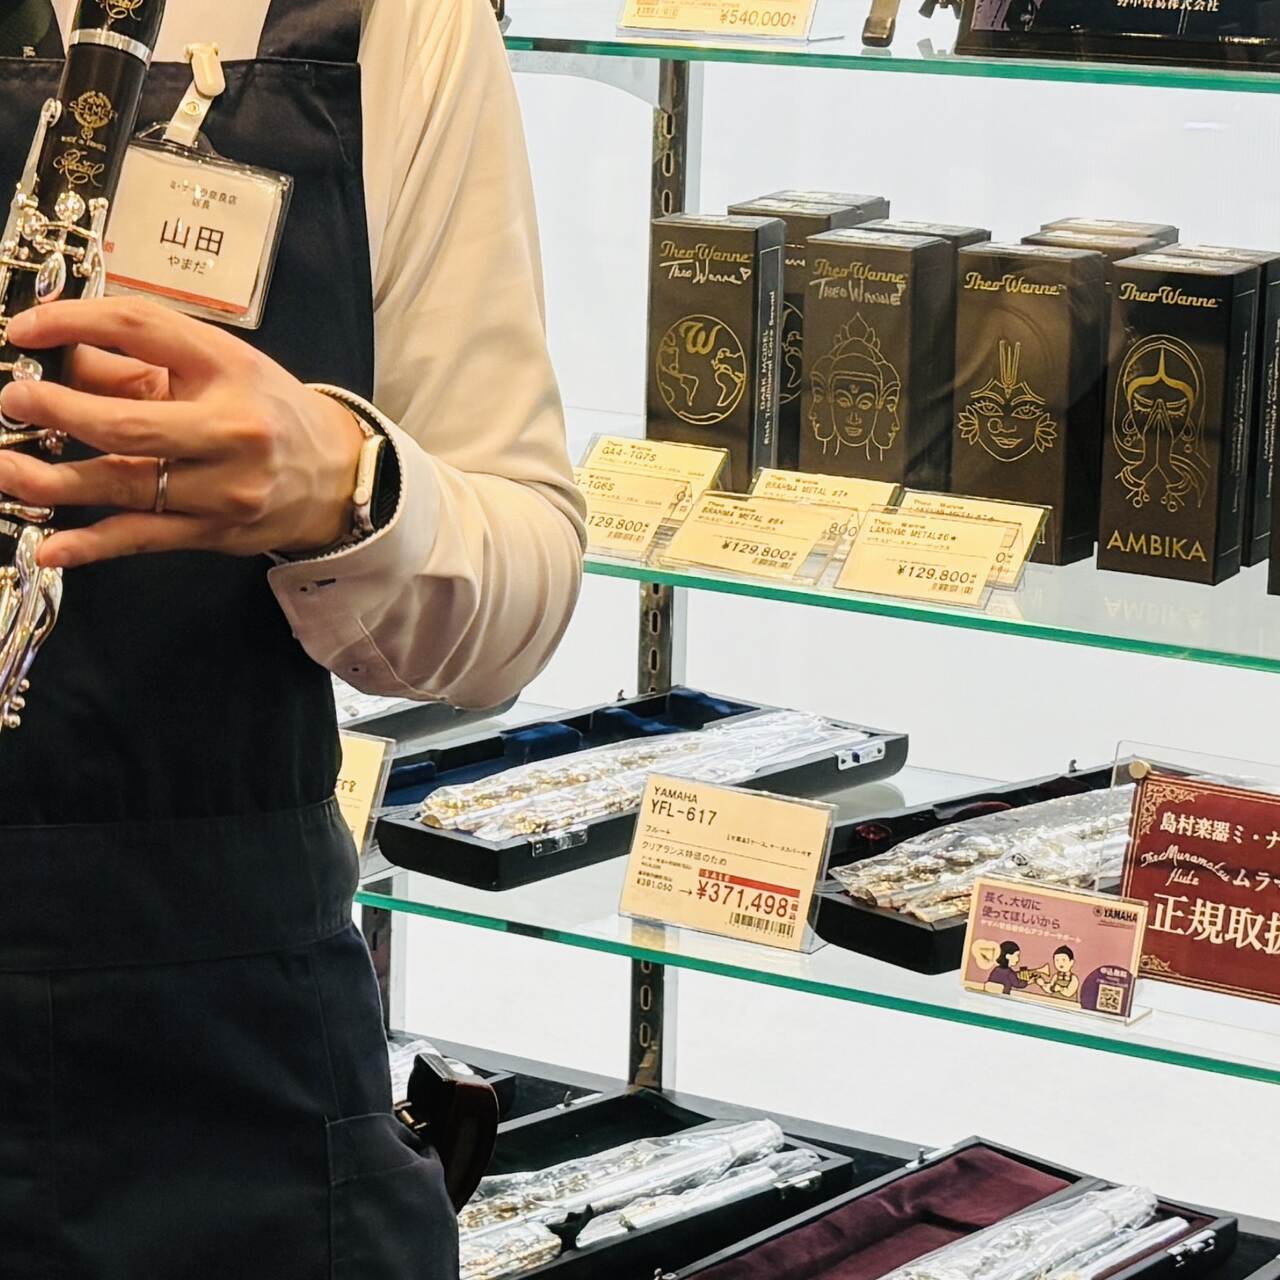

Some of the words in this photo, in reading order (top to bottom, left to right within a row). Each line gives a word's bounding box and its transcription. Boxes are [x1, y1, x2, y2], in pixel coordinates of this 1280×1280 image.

[720, 9, 792, 28] ¥540,000
[159, 216, 225, 257] 山田
[659, 240, 694, 259] Theo
[693, 242, 754, 264] Wanne
[167, 254, 212, 276] やまだ
[813, 258, 850, 279] Theo
[849, 259, 908, 285] Wanne
[964, 271, 1002, 291] Theo
[1001, 273, 1061, 296] Wanne
[1119, 282, 1161, 303] Theo
[1160, 285, 1219, 309] Wanne
[588, 516, 644, 533] 129,800
[721, 539, 791, 562] ¥129,800
[1106, 528, 1208, 563] AMBIKA
[897, 564, 970, 585] ¥129,800
[653, 785, 699, 804] YAMAHA
[650, 798, 718, 826] YFL-617
[645, 824, 672, 835] フルート
[1159, 811, 1280, 849] 島村楽器ミ・ナ
[641, 840, 728, 866] クリアランス特価のため
[696, 879, 789, 919] ¥371,498
[984, 891, 1042, 911] 長く、大切に
[982, 905, 1061, 930] 使ってほしいから
[1102, 906, 1138, 922] YAMAHA
